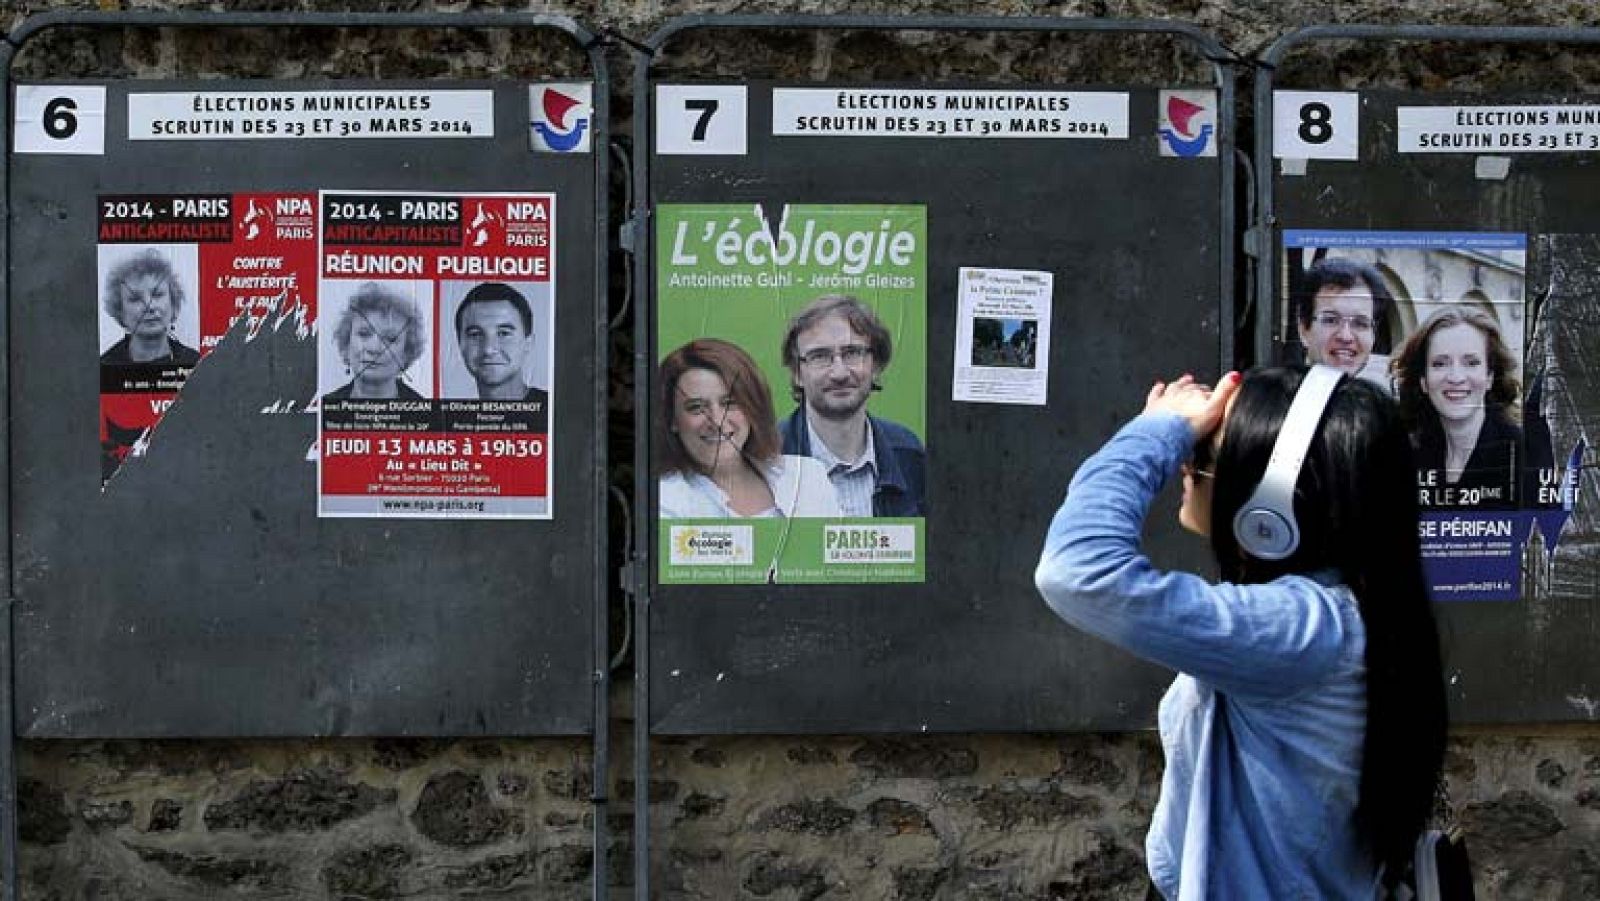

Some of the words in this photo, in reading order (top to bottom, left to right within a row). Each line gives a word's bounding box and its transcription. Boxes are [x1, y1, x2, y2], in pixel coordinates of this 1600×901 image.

[193, 94, 295, 112] ÉLECTIONS
[303, 95, 431, 112] MUNICIPALES
[837, 92, 937, 111] ÉLECTIONS
[945, 95, 1070, 112] MUNICIPALES
[42, 97, 78, 139] 6
[684, 100, 719, 141] 7
[796, 116, 877, 132] SCRUTIN
[885, 116, 919, 133] DES
[926, 120, 947, 135] 23
[953, 117, 975, 133] ET
[981, 120, 1002, 136] 30
[1010, 117, 1061, 133] MARS
[1067, 120, 1109, 136] 2014
[1298, 102, 1333, 144] 8
[1456, 108, 1549, 126] ÉLECTIONS
[152, 118, 234, 134] SCRUTIN
[242, 118, 276, 134] DES
[284, 121, 305, 137] 23
[313, 117, 334, 134] ET
[340, 121, 362, 137] 30
[370, 117, 423, 134] MARS
[430, 120, 472, 136] 2014
[1419, 133, 1492, 147] SCRUTIN
[1499, 132, 1532, 147] DES
[1539, 135, 1557, 149] 23
[1565, 131, 1584, 146] ET
[104, 202, 153, 219] 2014
[172, 199, 230, 218] PARIS
[276, 199, 313, 216] NPA
[329, 202, 382, 220] 2014
[401, 201, 459, 220] PARIS
[507, 202, 547, 220] NPA
[101, 221, 230, 240] ANTICAPITALISTE
[276, 227, 313, 240] PARIS
[325, 224, 460, 241] ANTICAPITALISTE
[507, 234, 547, 247] PARIS
[233, 256, 283, 270] CONTRE
[326, 251, 423, 274] RÉUNION
[437, 255, 547, 275] PUBLIQUE
[668, 271, 753, 288] Antoinette
[757, 271, 793, 288] Guhl
[864, 273, 915, 288] Gleizes
[389, 402, 432, 411] DUGGAN
[449, 402, 479, 411] Olivier
[482, 402, 542, 411] BESANCENOT
[326, 438, 370, 456] JEUDI
[378, 439, 401, 456] 13
[409, 440, 456, 456] MARS
[462, 437, 473, 455] à
[480, 440, 543, 457] 19h30
[386, 460, 403, 470] Au
[420, 459, 447, 471] Lieu
[451, 459, 470, 470] Dit
[1435, 488, 1455, 505] LE
[384, 500, 484, 512] www.npa-paris.org
[1441, 516, 1511, 537] PÉRIFAN
[826, 529, 878, 549] PARIS
